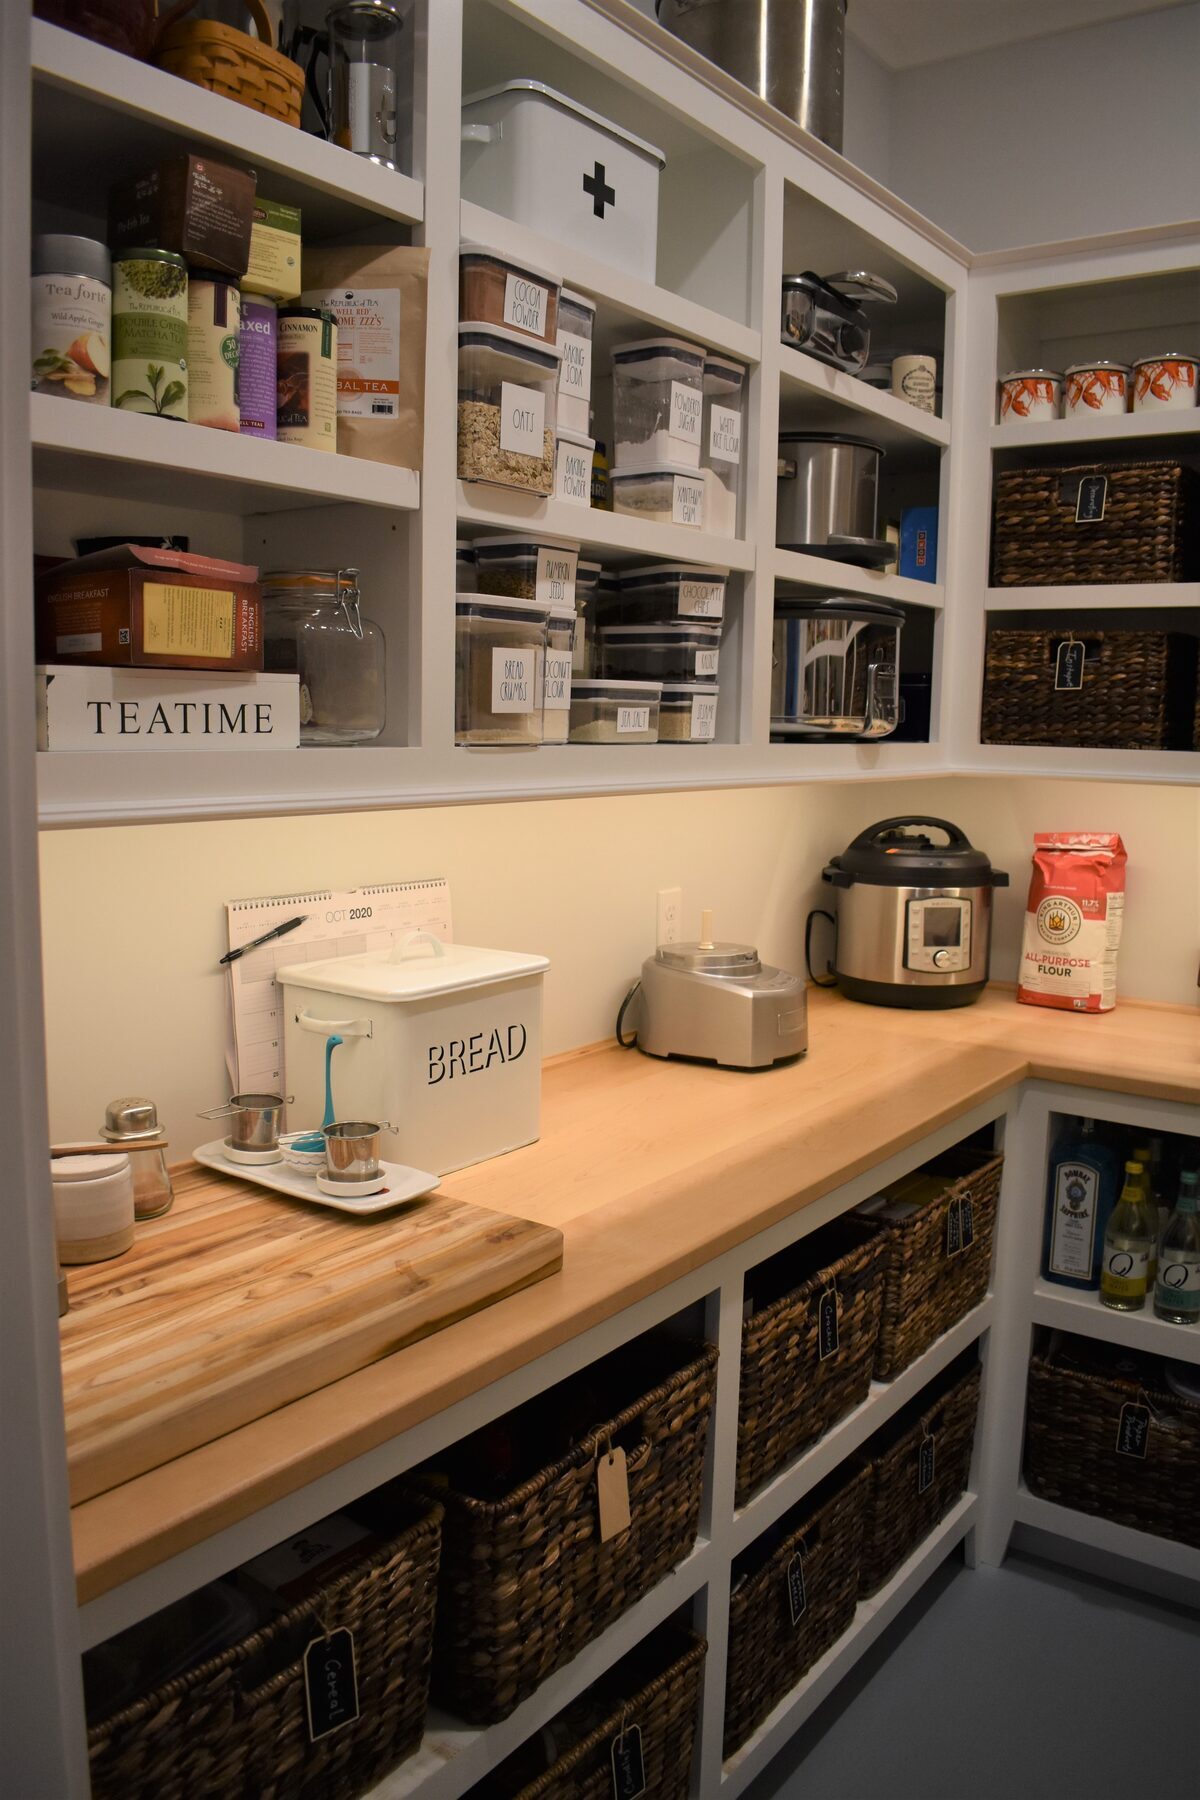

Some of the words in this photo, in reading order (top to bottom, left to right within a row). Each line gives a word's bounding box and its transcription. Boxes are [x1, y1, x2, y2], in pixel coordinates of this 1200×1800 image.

[45, 283, 71, 296] Tea
[514, 280, 541, 310] COCOA
[367, 299, 379, 307] TEA
[51, 312, 67, 320] Wild
[68, 314, 87, 324] Apple
[337, 316, 355, 326] OME
[511, 301, 540, 331] POWDER
[124, 329, 168, 339] MATCHA
[170, 332, 185, 345] TEA
[239, 320, 271, 335] axed
[280, 323, 318, 333] CINNAMON
[563, 343, 585, 367] BAKING
[565, 363, 583, 388] SODA
[364, 382, 388, 392] TEA
[674, 391, 700, 417] POWDERED
[512, 408, 534, 432] OATS
[678, 412, 696, 433] SUGAR
[719, 416, 735, 435] WHITE
[565, 455, 586, 478] BAKING
[563, 475, 586, 498] POWDER
[682, 506, 696, 523] GUM
[918, 532, 926, 565] ZOKU
[545, 560, 571, 581] PUMPKIN
[47, 592, 72, 603] ENGLISH
[73, 588, 110, 600] BREAKFAST
[549, 581, 565, 601] SEEDS
[682, 584, 722, 601] CHOCOLATE
[693, 600, 710, 615] CHIPS
[241, 599, 249, 652] BREAKFAST
[504, 660, 524, 680] BREAD
[539, 660, 571, 680] COCONUT
[500, 681, 527, 702] CRUMBS
[543, 680, 565, 699] FLOUR
[86, 701, 274, 734] TEATIME
[621, 711, 631, 728] SEA
[632, 711, 647, 728] SALT
[326, 909, 348, 924] OCT
[349, 906, 373, 920] 2020
[1040, 902, 1052, 917] KING
[1053, 901, 1078, 920] ARTHUR
[1025, 951, 1091, 968] ALL-PURPOSE
[1037, 964, 1072, 977] FLOUR
[427, 1023, 527, 1085] BREAD
[1064, 1169, 1091, 1184] BOMBAY
[1060, 1204, 1090, 1219] SAPPHIRE
[1109, 1252, 1134, 1279] Q
[1163, 1263, 1189, 1290] Q
[825, 1304, 834, 1353] Crackers
[323, 1658, 344, 1721] Cereal
